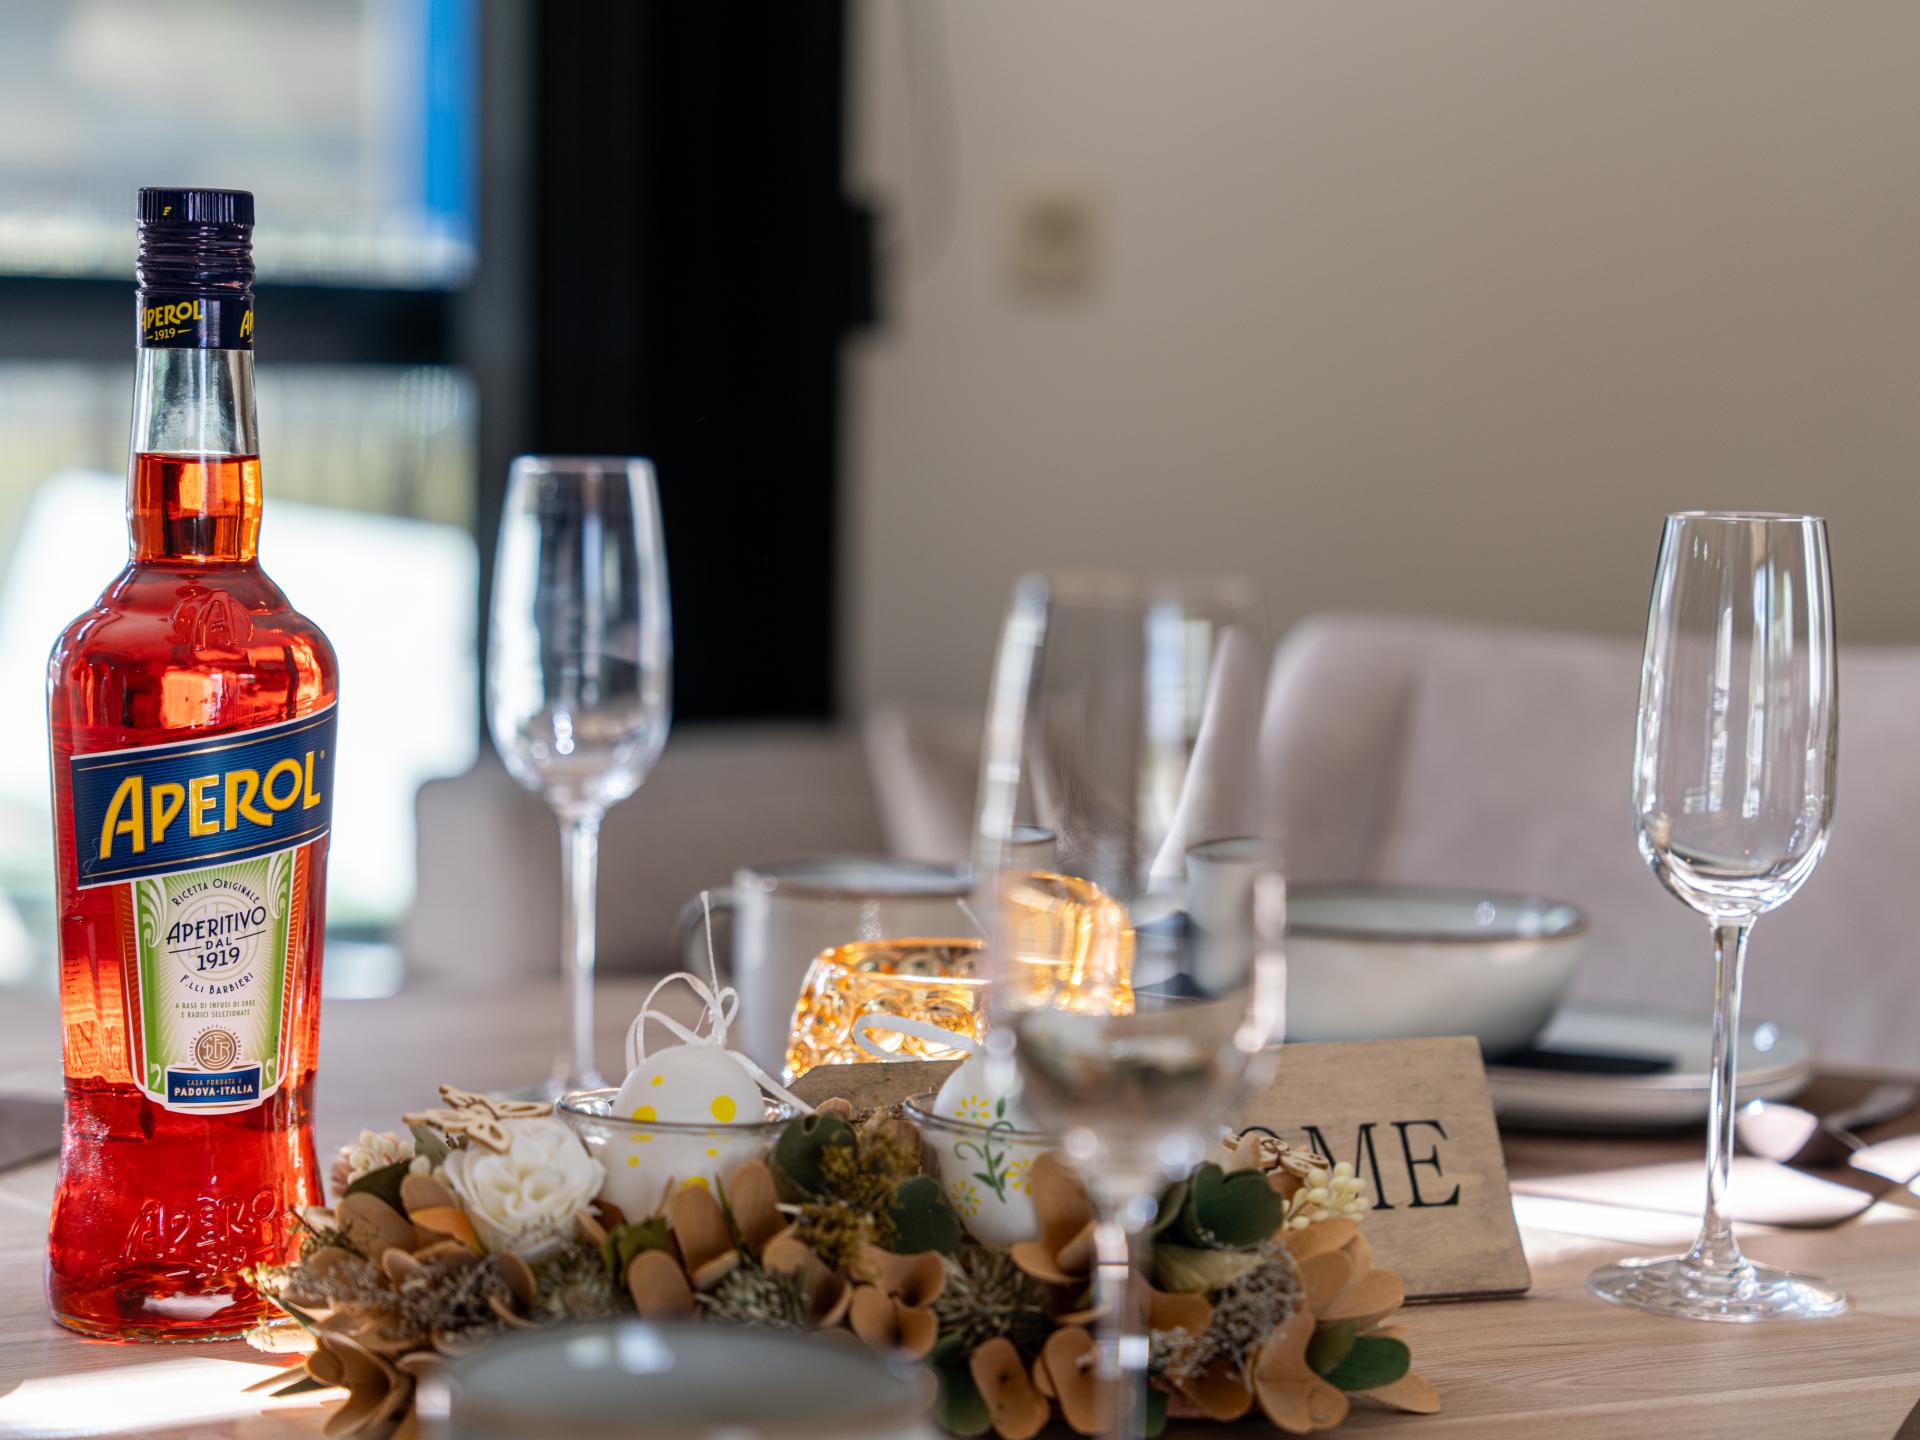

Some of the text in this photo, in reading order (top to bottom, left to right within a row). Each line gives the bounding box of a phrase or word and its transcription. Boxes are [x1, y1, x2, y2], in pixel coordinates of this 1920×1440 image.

[141, 300, 204, 332] APEROL
[154, 327, 176, 341] 1919
[100, 750, 321, 860] APEROL
[166, 906, 267, 946] APERITIVO
[205, 937, 233, 950] DAL
[196, 946, 241, 972] 1919
[209, 972, 254, 995] BARBIERI
[1237, 1120, 1460, 1210] ME
